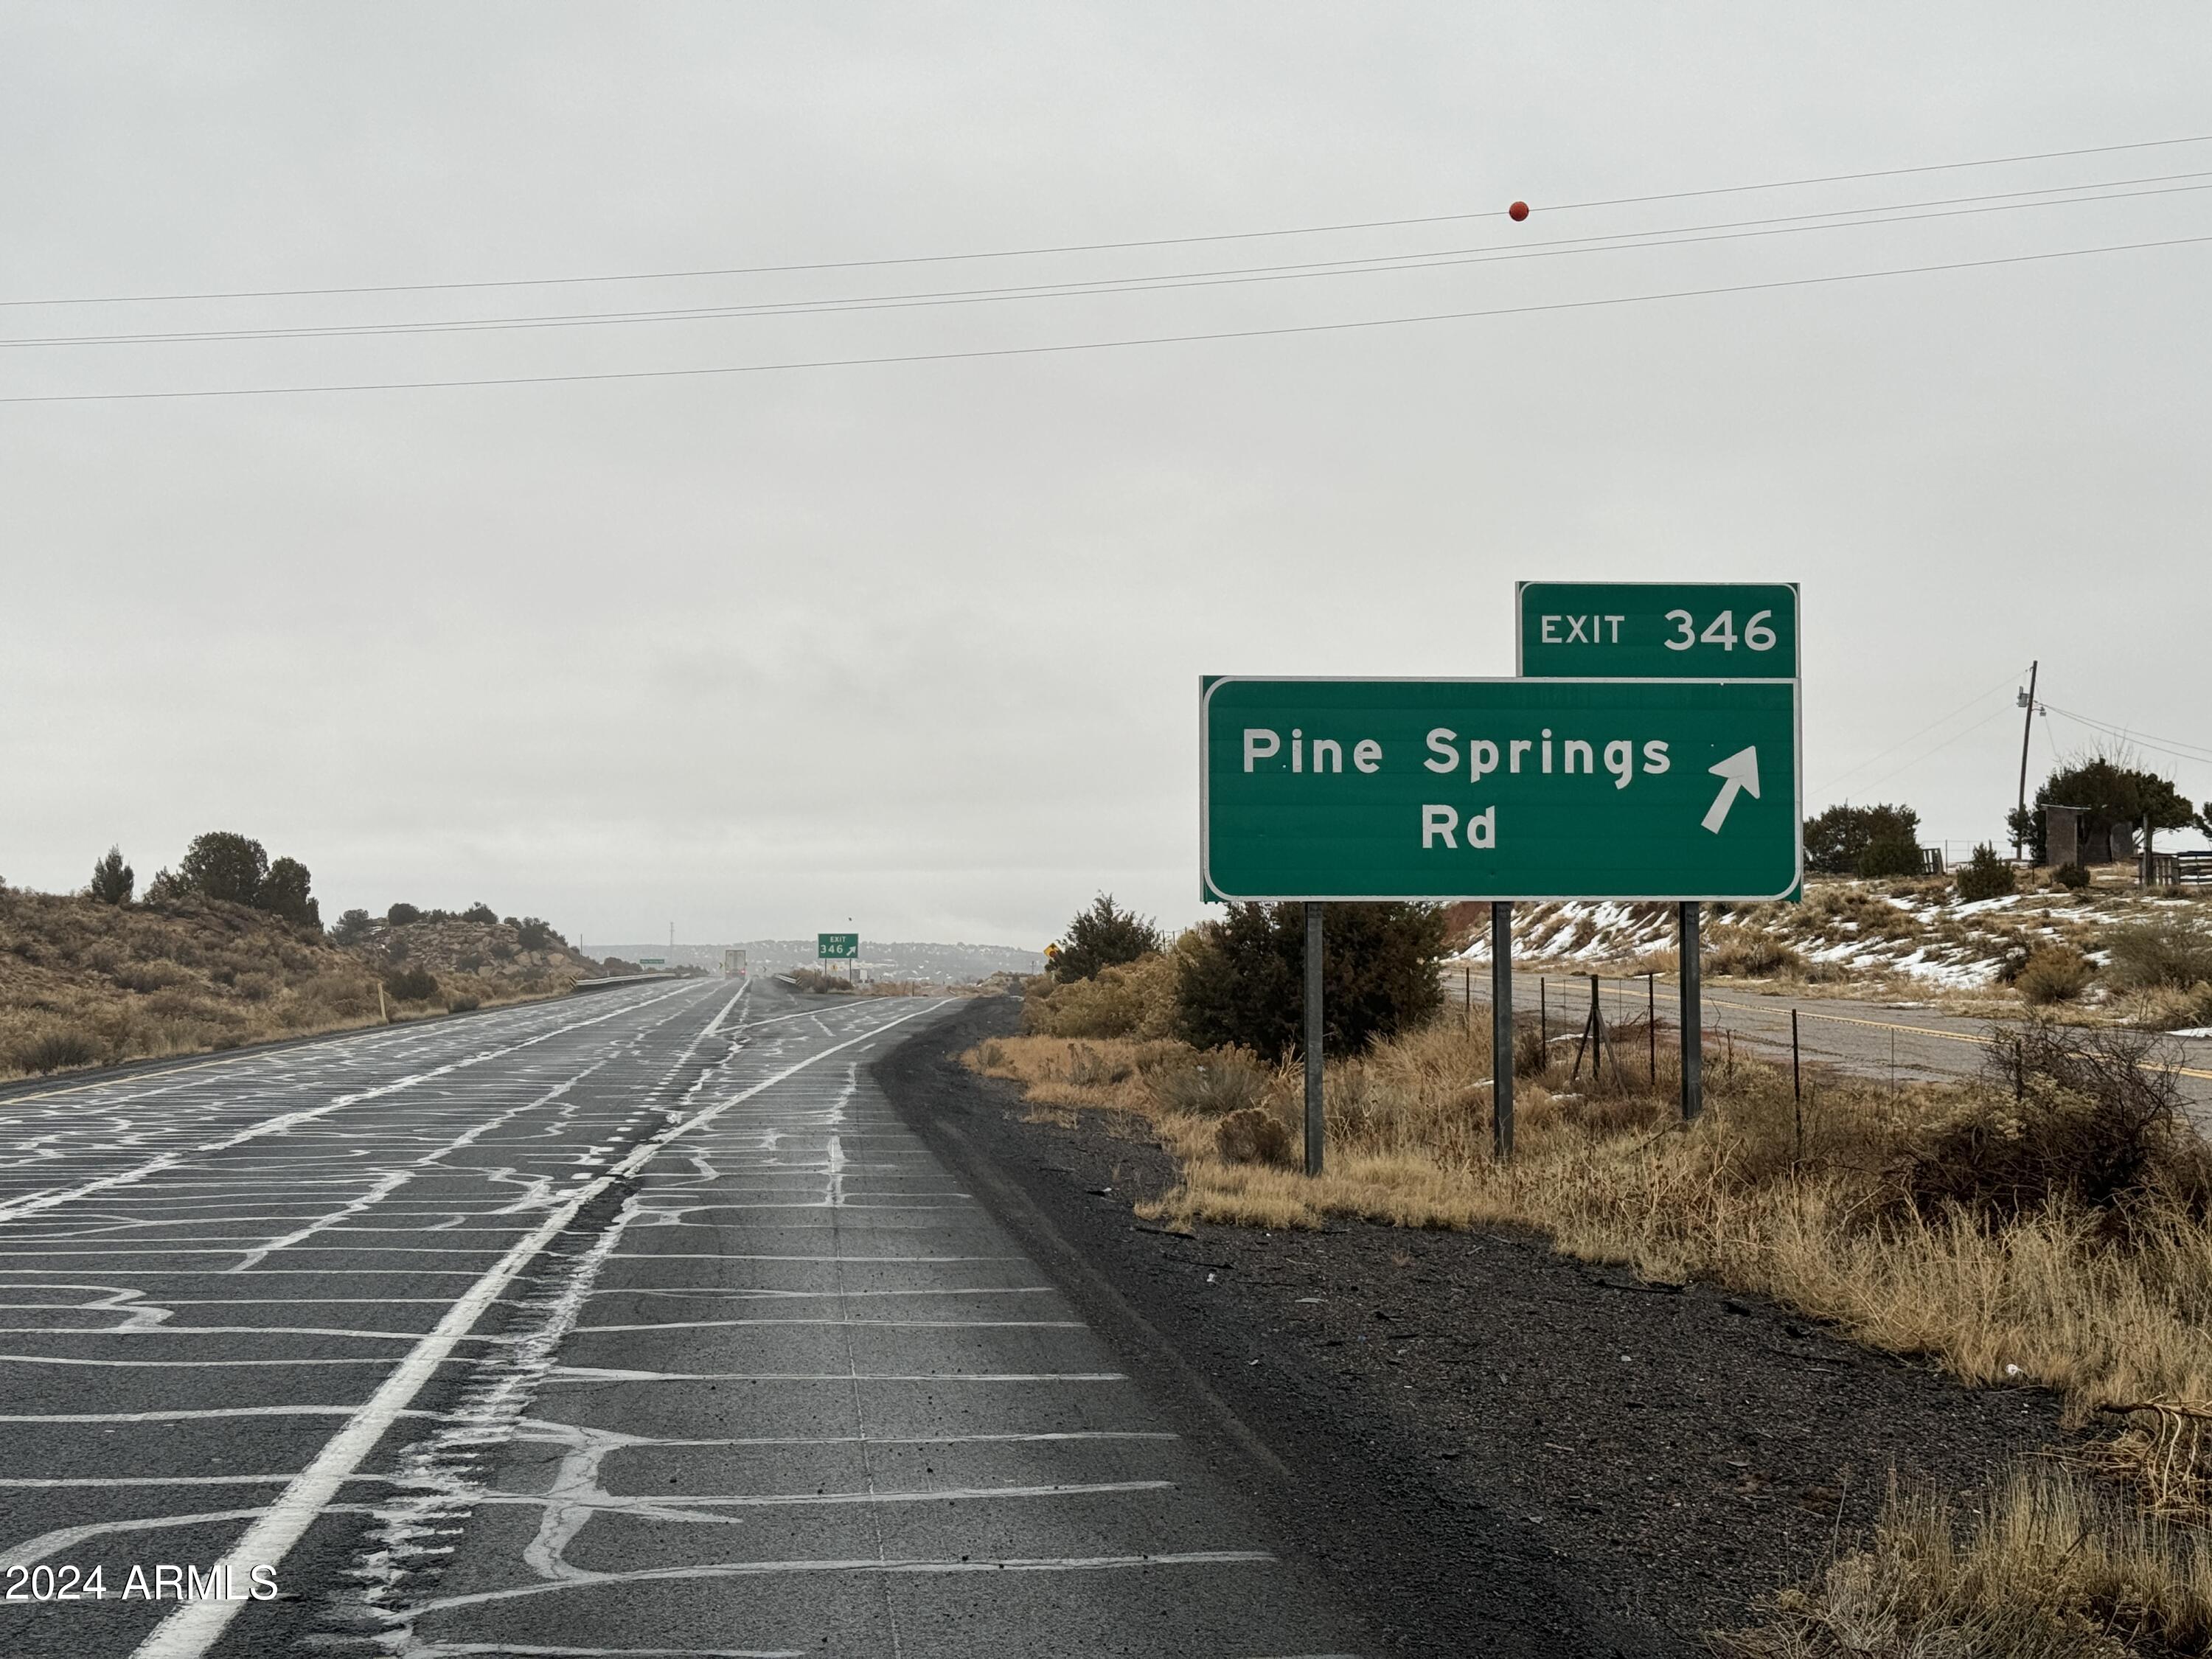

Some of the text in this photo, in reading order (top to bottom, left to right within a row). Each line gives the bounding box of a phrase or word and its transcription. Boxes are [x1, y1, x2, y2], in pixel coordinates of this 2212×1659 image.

[1541, 609, 1777, 651] EXIT 346
[1243, 727, 1671, 790] Pine Springs
[1422, 804, 1496, 849] Rd
[820, 945, 844, 953] 346
